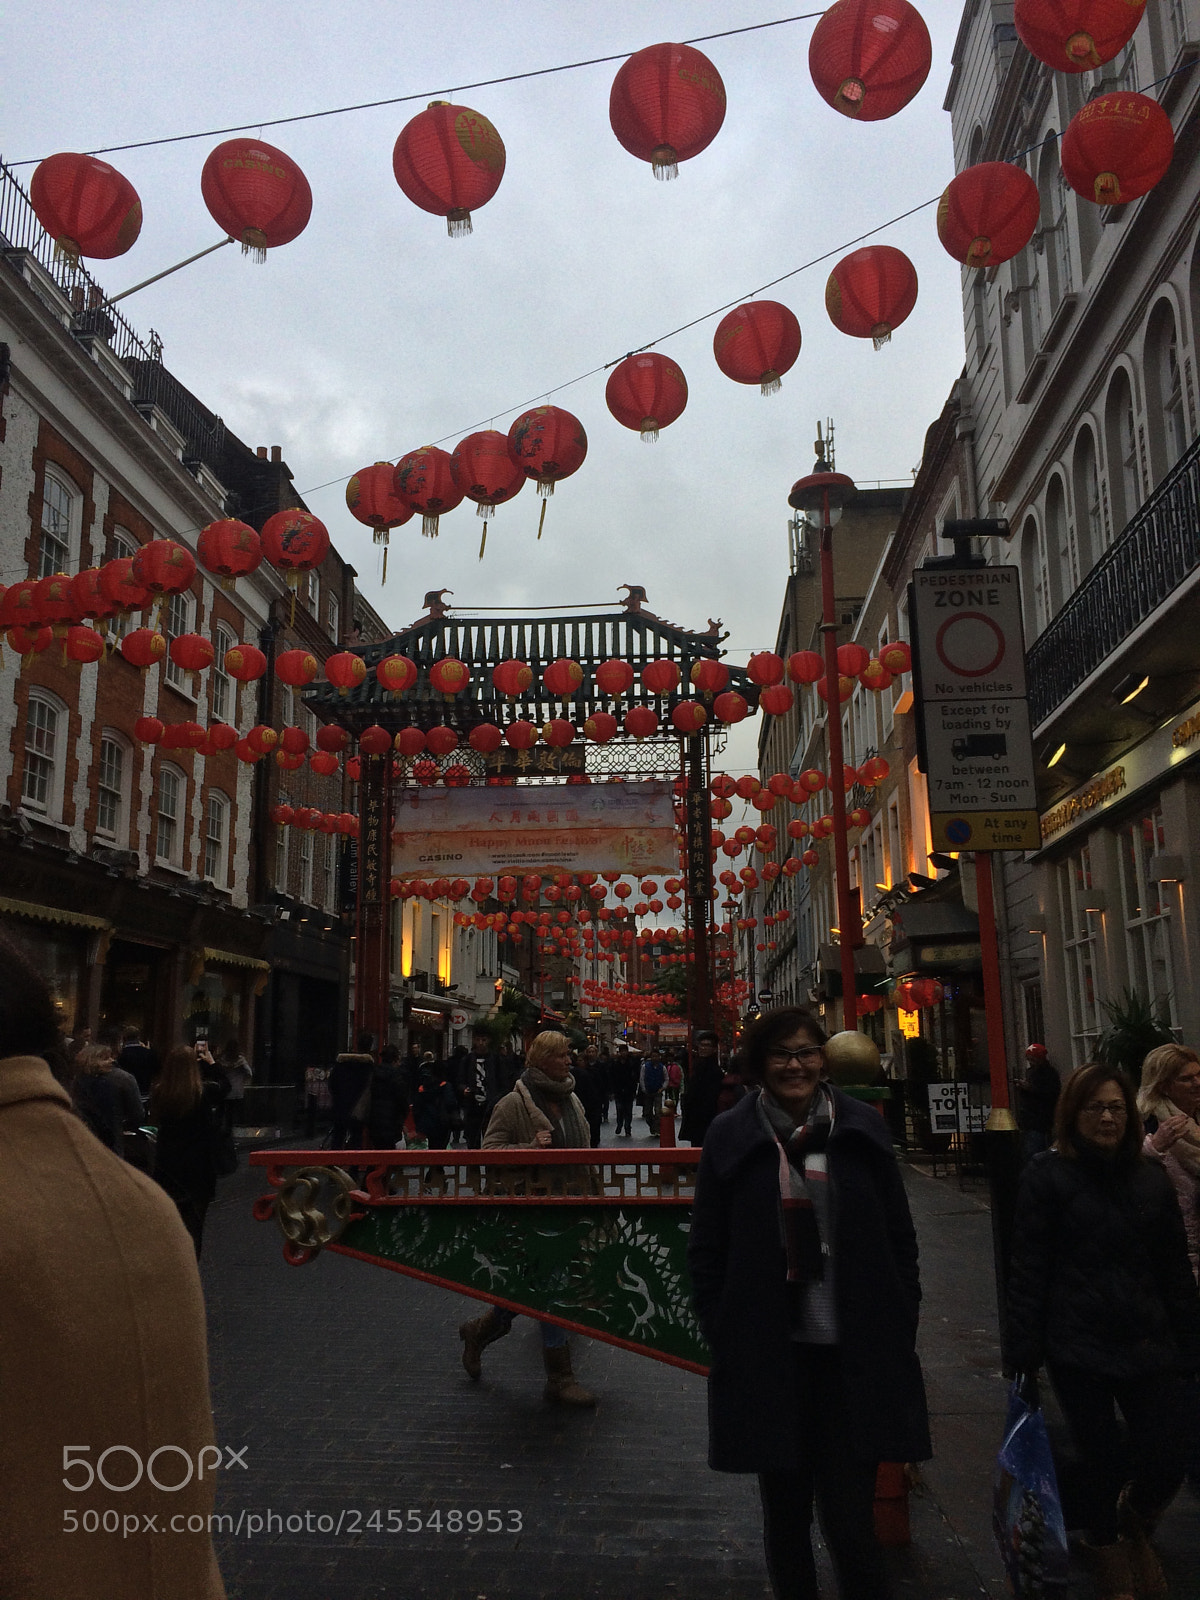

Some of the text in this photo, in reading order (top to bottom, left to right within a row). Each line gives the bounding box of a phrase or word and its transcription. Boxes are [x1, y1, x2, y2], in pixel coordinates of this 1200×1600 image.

[222, 159, 285, 179] CASINO
[920, 573, 1011, 586] PEDESTRIAN
[934, 589, 1000, 607] ZONE
[935, 681, 1013, 694] No vehicles
[941, 704, 1010, 716] Except for
[942, 718, 1011, 730] loading by
[952, 765, 1009, 775] between
[935, 779, 964, 790] 7am
[977, 778, 991, 788] 12
[996, 778, 1029, 788] noon
[950, 793, 978, 804] Mon
[990, 792, 1017, 803] Sun
[984, 817, 1028, 830] At any
[992, 833, 1022, 843] time
[418, 853, 463, 862] CASINO
[941, 1087, 968, 1096] OFFI
[932, 1098, 957, 1110] TO
